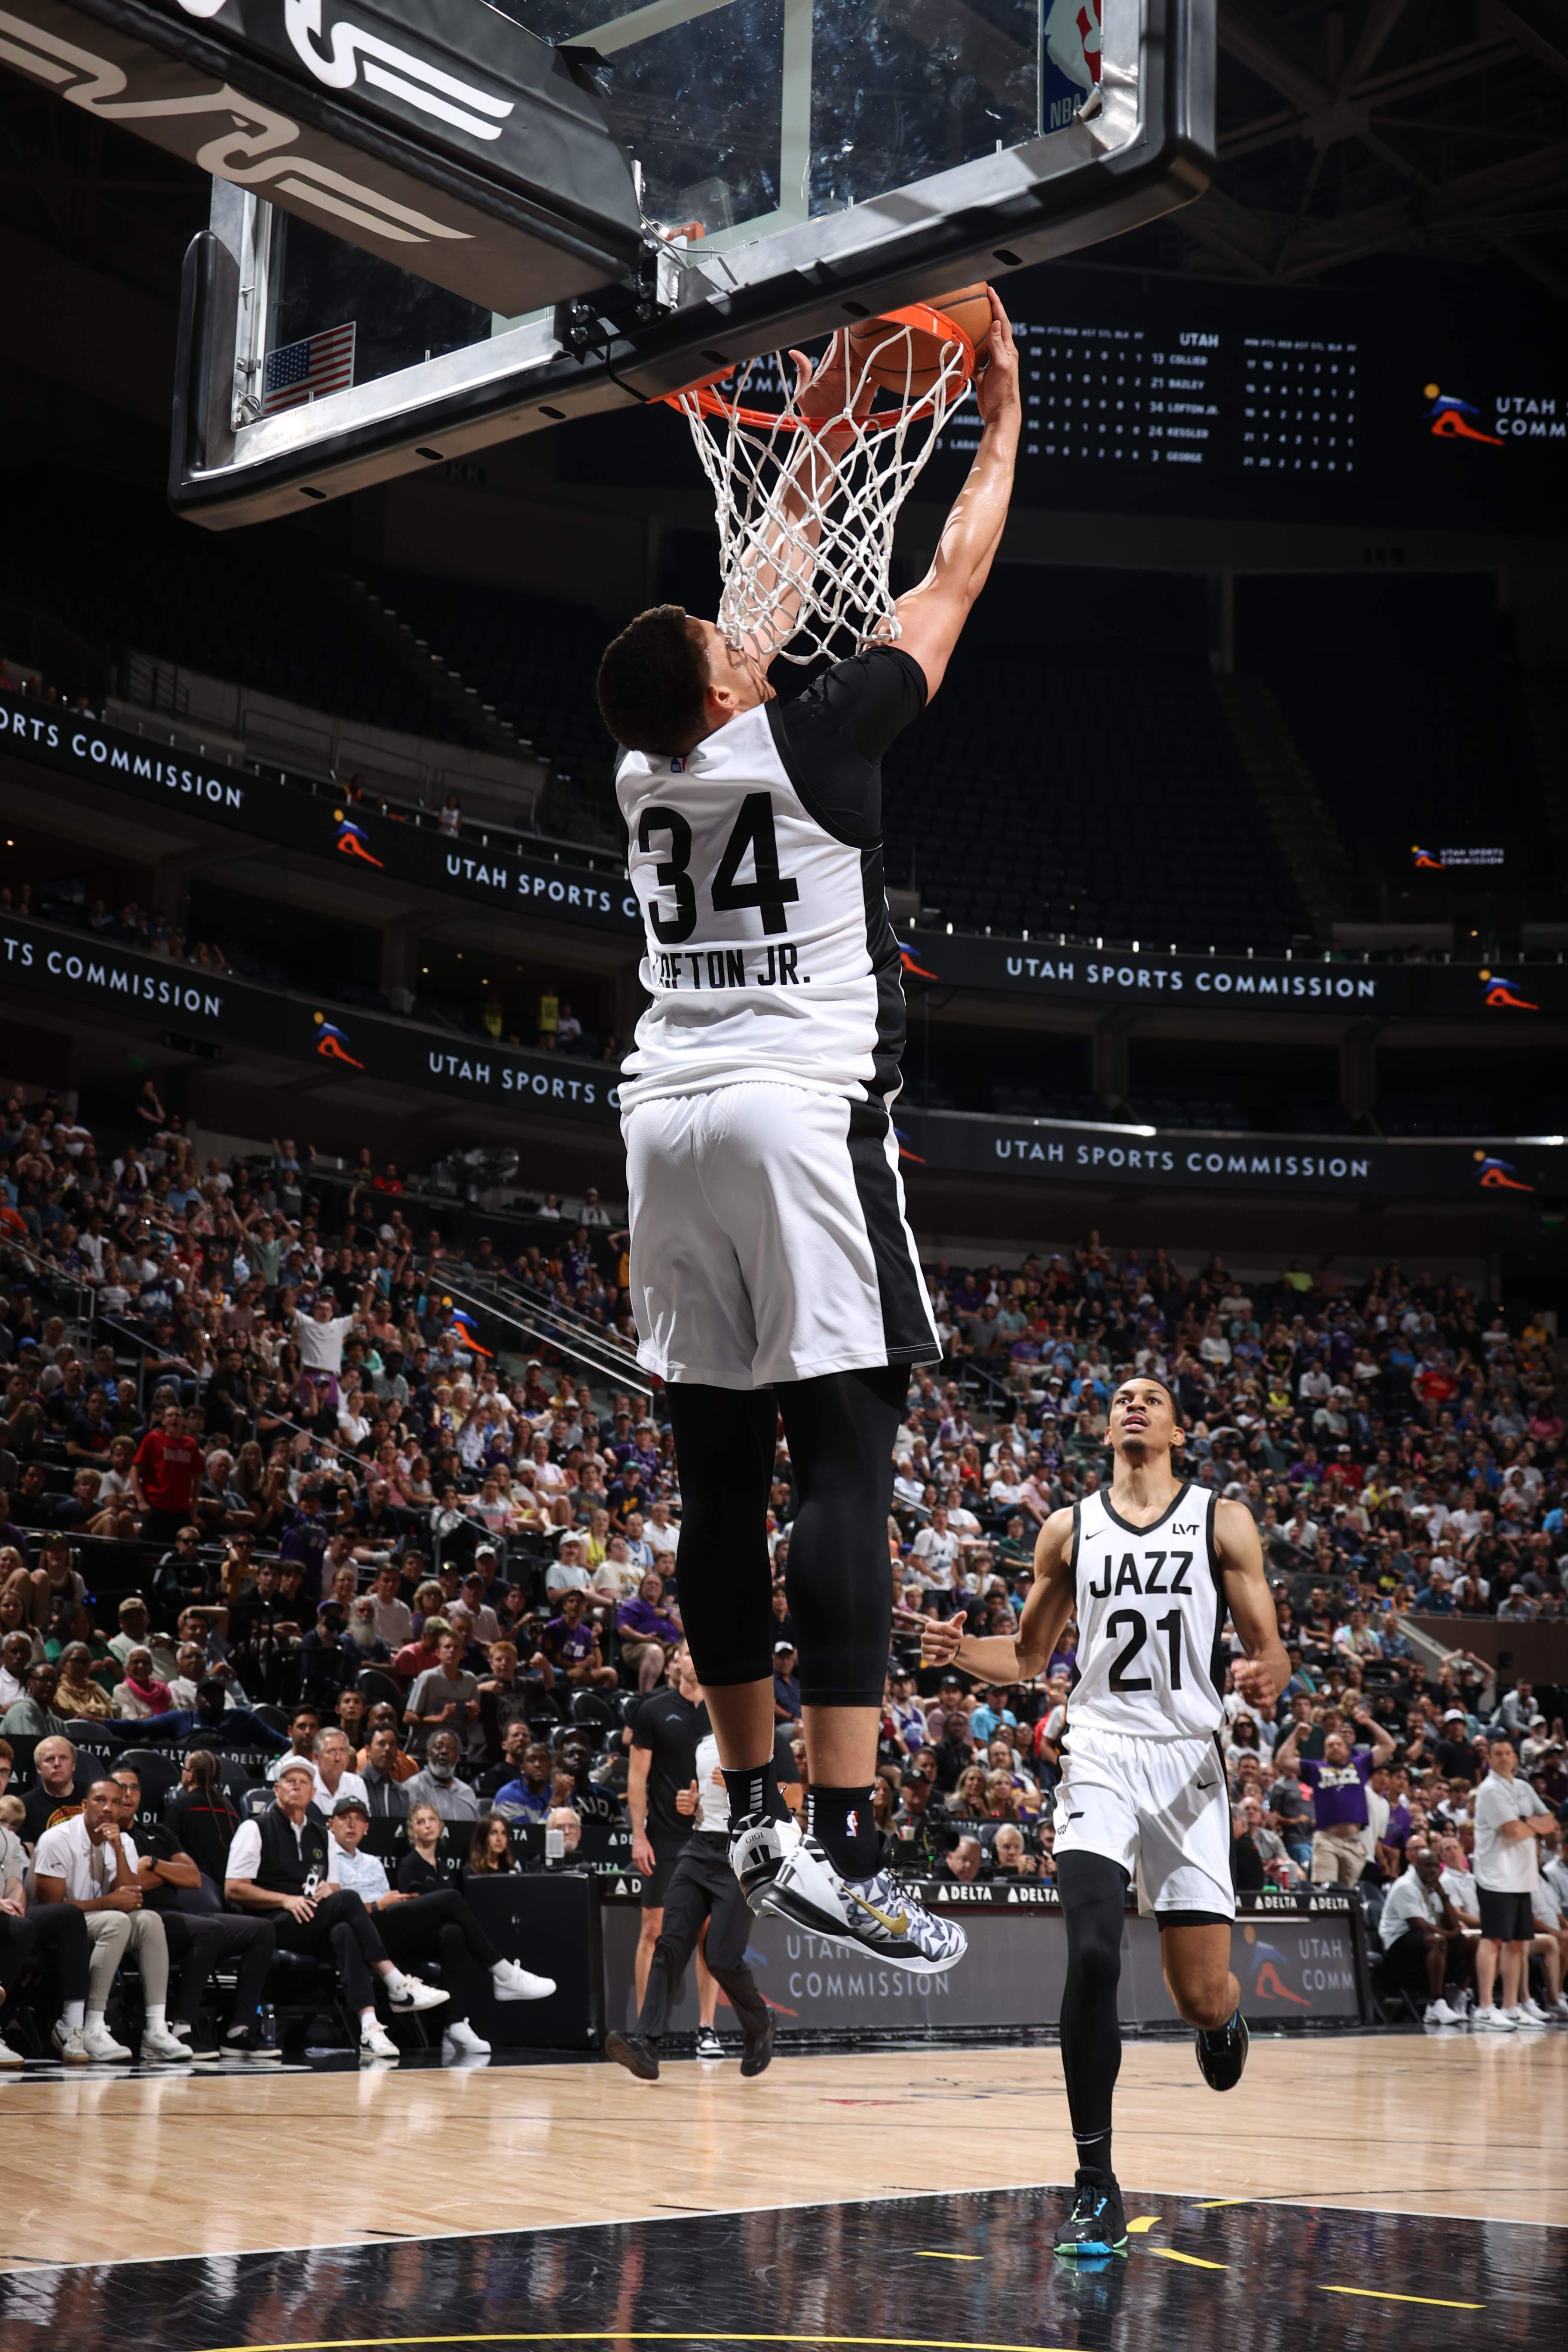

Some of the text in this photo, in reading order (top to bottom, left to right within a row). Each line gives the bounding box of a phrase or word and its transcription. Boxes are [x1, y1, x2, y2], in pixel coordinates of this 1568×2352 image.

[1179, 332, 1219, 348] UTAH
[1100, 351, 1109, 361] 0
[1119, 352, 1125, 361] 1
[1136, 353, 1142, 362] 1
[1151, 352, 1164, 365] 13
[1169, 354, 1208, 366] COLLIER
[1262, 361, 1273, 370] 10
[1331, 364, 1338, 374] 0
[1066, 373, 1072, 383] 1
[1083, 374, 1091, 384] 0
[1101, 375, 1107, 385] 1
[1117, 376, 1125, 386] 0
[1150, 377, 1164, 389] 21
[1168, 378, 1205, 390] BAZLEY
[1263, 385, 1271, 394] 4
[1280, 386, 1287, 395] 4
[1297, 387, 1303, 396] 1
[1313, 387, 1321, 397] 0
[1331, 389, 1337, 398] 1
[1064, 397, 1072, 407] 0
[1082, 398, 1090, 408] 0
[1099, 399, 1107, 409] 0
[1116, 400, 1124, 410] 0
[1134, 401, 1140, 411] 1
[1149, 401, 1164, 413] 34
[1167, 402, 1204, 414] LOFTON
[1205, 405, 1220, 415] JR.
[1262, 409, 1270, 418] 4
[1312, 412, 1320, 421] 0
[1329, 413, 1337, 422] 0
[1496, 396, 1556, 416] UTAH
[1047, 421, 1054, 430] 4
[1082, 423, 1088, 432] 1
[1098, 423, 1106, 433] 0
[1115, 424, 1123, 435] 0
[1132, 426, 1140, 435] 0
[1148, 425, 1164, 438] 24
[1167, 426, 1209, 439] KESSLER
[1279, 434, 1286, 443] 4
[1313, 436, 1319, 445] 1
[1347, 438, 1353, 447] 1
[1115, 449, 1123, 459] 0
[1152, 450, 1159, 462] 3
[1166, 451, 1203, 463] GEORGE
[1311, 460, 1319, 470] 0
[1328, 461, 1335, 471] 0
[73, 735, 241, 808] COMMISSION
[1439, 847, 1504, 857] UTAH SPORTS
[1439, 856, 1504, 865] COMMISSION
[638, 791, 799, 945] 34
[447, 855, 506, 888] UTAH
[519, 875, 610, 911] SPORTS
[660, 943, 811, 989] OFTON JR.
[48, 952, 219, 1015] COMMISSION
[1008, 957, 1374, 997] UTAH SPORTS COMMISSION
[430, 1053, 490, 1083] UTAH
[502, 1069, 594, 1103] SPORTS
[997, 1140, 1367, 1177] UTAH SPORTS COMMISSION
[1172, 1523, 1200, 1536] LVT
[1090, 1551, 1194, 1599] JAZZ
[1106, 1609, 1182, 1692] 21
[745, 1832, 763, 1844] GIGI
[791, 1851, 799, 1862] 2
[951, 1885, 992, 1901] DELTA
[1020, 1887, 1059, 1902] DELTA
[1265, 1896, 1297, 1908] DELTA
[1318, 1897, 1350, 1910] DELTA
[1298, 1938, 1343, 1959] UTAH
[789, 1972, 949, 1998] COMMISSION
